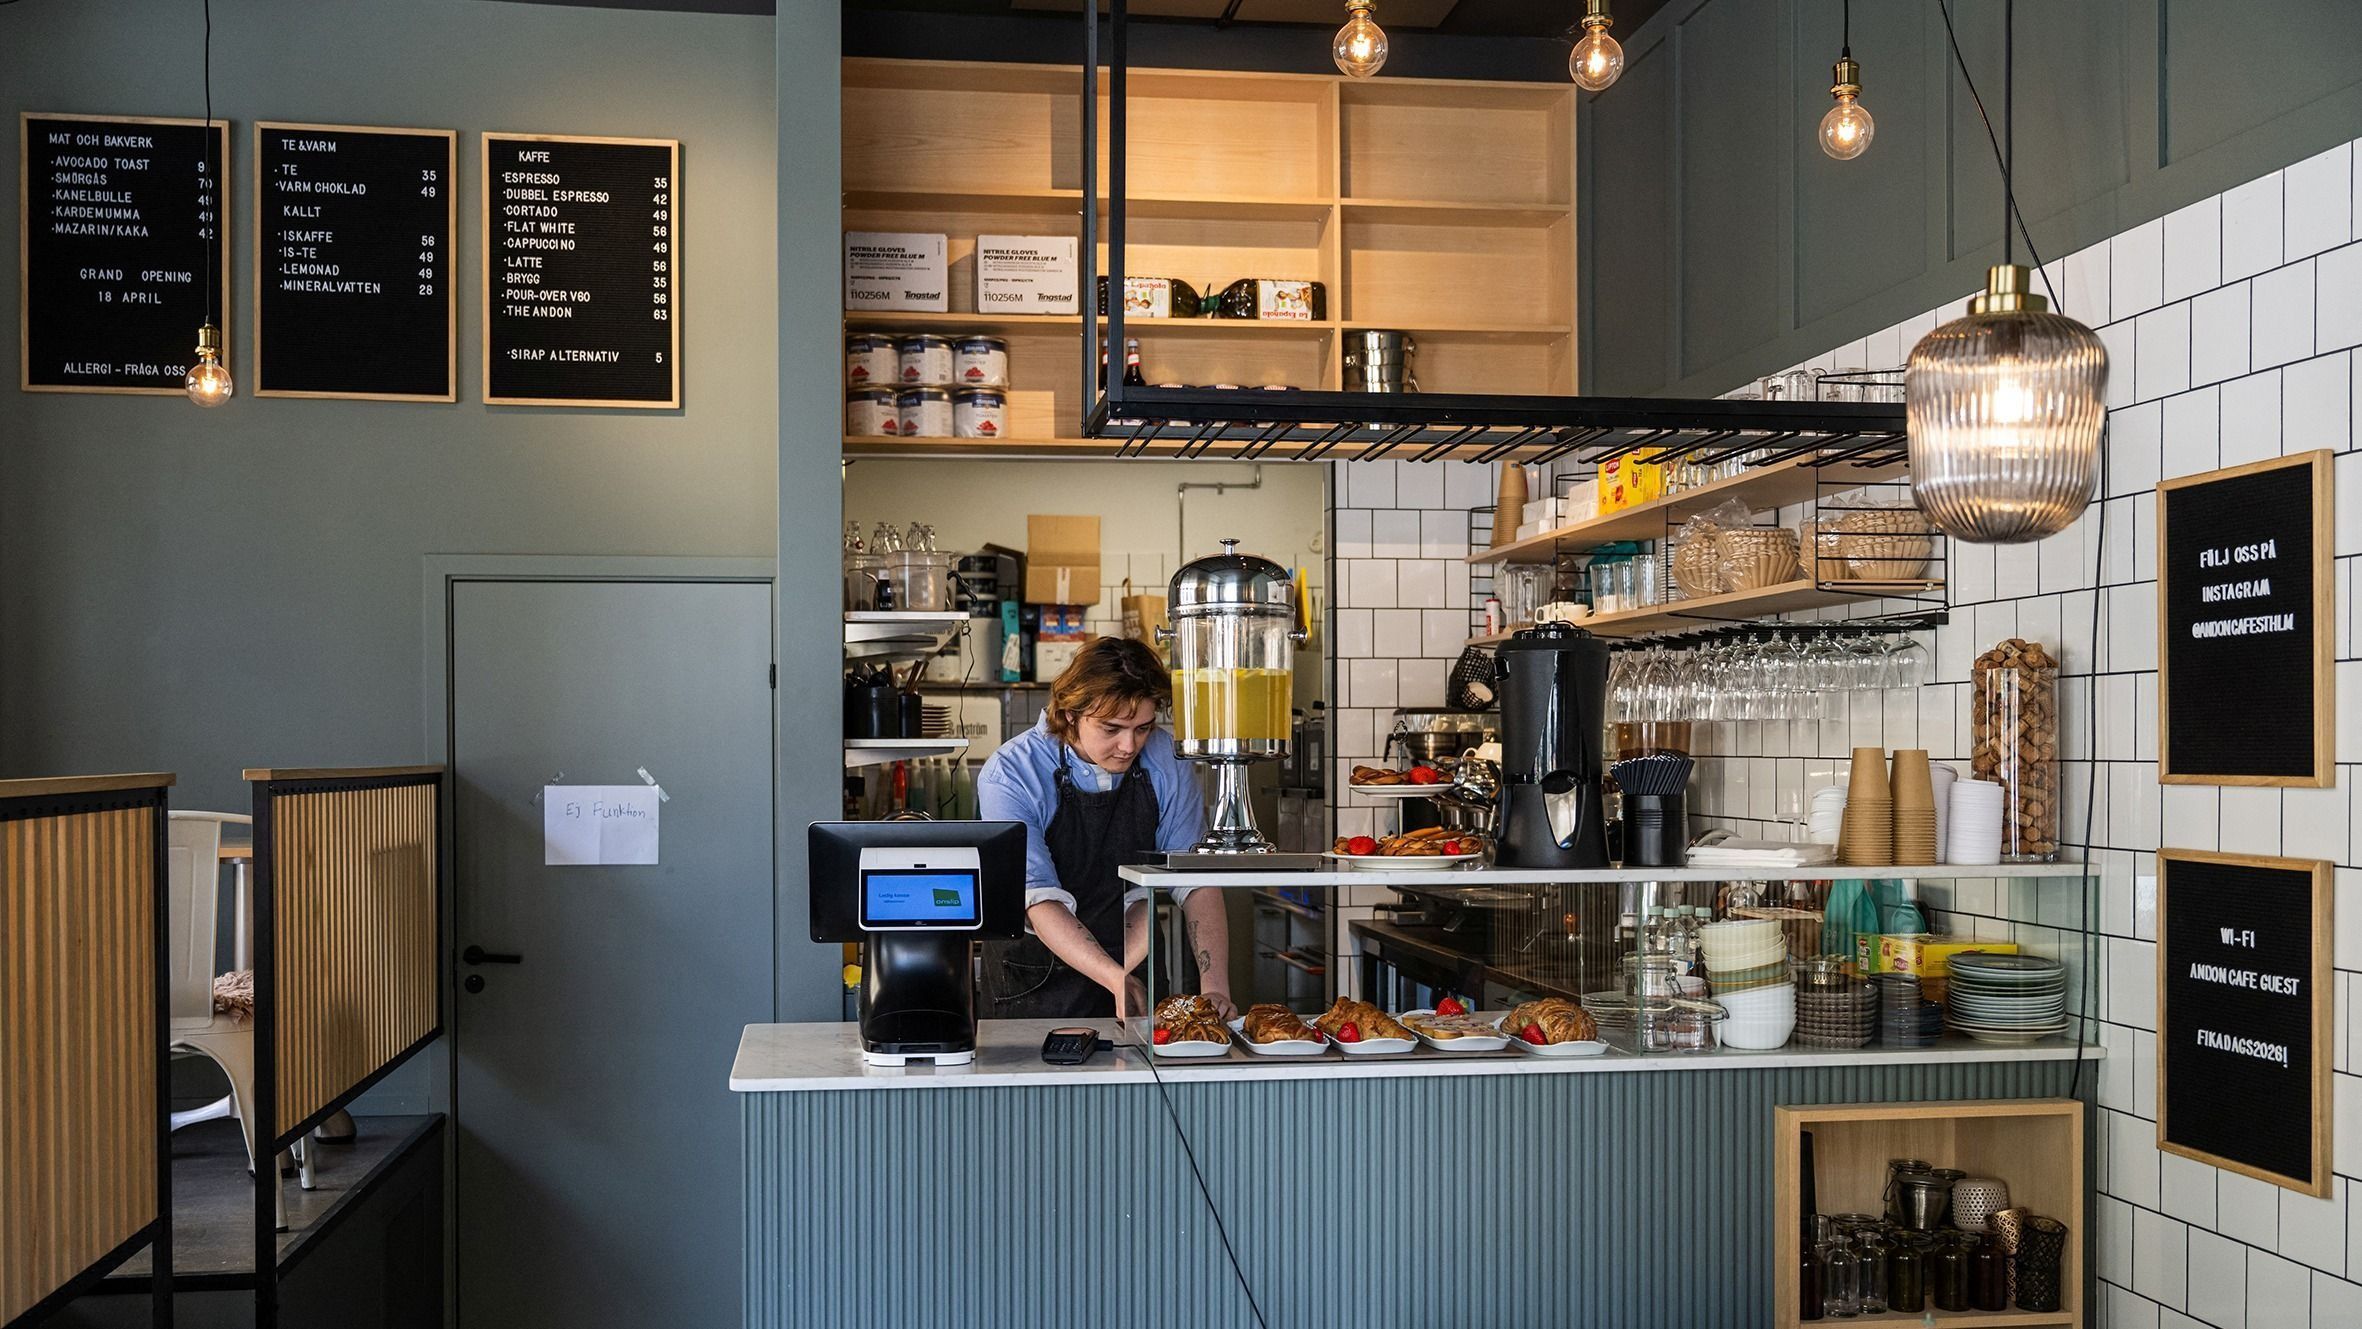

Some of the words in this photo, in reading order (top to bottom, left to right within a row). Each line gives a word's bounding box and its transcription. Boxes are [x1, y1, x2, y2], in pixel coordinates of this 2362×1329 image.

[50, 134, 70, 144] MAT
[77, 135, 98, 145] OCH
[105, 136, 152, 148] BAKVERK
[282, 139, 295, 150] TE
[56, 156, 107, 168] AVOCADO
[115, 159, 149, 170] TOAST
[519, 151, 550, 162] KAFFE
[282, 164, 297, 175] TE
[422, 170, 436, 181] 35
[505, 172, 560, 185] ESPRESSO
[654, 178, 667, 188] 35
[56, 190, 131, 203] KANELBULLE
[279, 181, 310, 192] VARM
[315, 182, 366, 195] CHOKLAD
[421, 187, 435, 197] 49
[507, 188, 548, 200] DUBBEL
[553, 190, 609, 203] ESPRESSO
[653, 194, 667, 205] 42
[56, 206, 140, 219] KARDEMUMMA
[284, 206, 321, 217] KALLT
[506, 205, 557, 217] CORTADO
[653, 210, 667, 221] 49
[56, 223, 148, 236] MAZARIN/KAKA
[508, 221, 536, 232] FLAT
[540, 222, 575, 234] WHITE
[653, 226, 667, 237] 56
[284, 231, 332, 242] ISKAFFE
[422, 235, 434, 246] 56
[507, 237, 575, 250] CAPPUCCINO
[653, 242, 667, 253] 49
[284, 247, 316, 258] IS-TE
[419, 252, 433, 262] 49
[284, 263, 339, 275] LEMONAD
[419, 268, 432, 279] 49
[508, 256, 542, 268] LATTE
[653, 261, 666, 271] 56
[80, 269, 122, 280] GRAND
[142, 271, 191, 283] OPENING
[507, 272, 540, 284] BRYGG
[653, 277, 666, 288] 35
[284, 280, 380, 293] MINERALVATTEN
[419, 284, 432, 295] 28
[850, 291, 890, 299] 110256M
[99, 291, 111, 302] 18
[123, 292, 161, 304] APRIL
[507, 289, 567, 301] POUR-OVER
[570, 291, 590, 302] V60
[653, 293, 666, 304] 56
[905, 291, 940, 300] Tingstad
[984, 293, 1023, 301] 110256M
[1038, 293, 1072, 301] Tingstad
[507, 305, 530, 316] THE
[533, 306, 571, 318] ANDON
[654, 309, 667, 320] 63
[511, 349, 545, 360] SIRAP
[550, 350, 619, 362] ALTERNATIV
[656, 352, 662, 363] 5
[64, 363, 111, 374] ALLERGI
[125, 363, 159, 375] FRÅGA
[164, 365, 186, 376] OSS
[2234, 545, 2259, 563] OSS
[2261, 539, 2276, 559] PÅ
[2202, 578, 2270, 602] INSTAGRAM
[2192, 613, 2294, 638] @ANDONCAFESTHLM
[566, 802, 580, 818] Ej
[593, 801, 645, 818] Funktion
[2221, 928, 2255, 948] WI-FI
[2190, 963, 2227, 984] ANDON
[2228, 969, 2257, 989] CAFE
[2260, 974, 2300, 995] GUEST
[2197, 1029, 2288, 1068] FIKADAGS2026!
